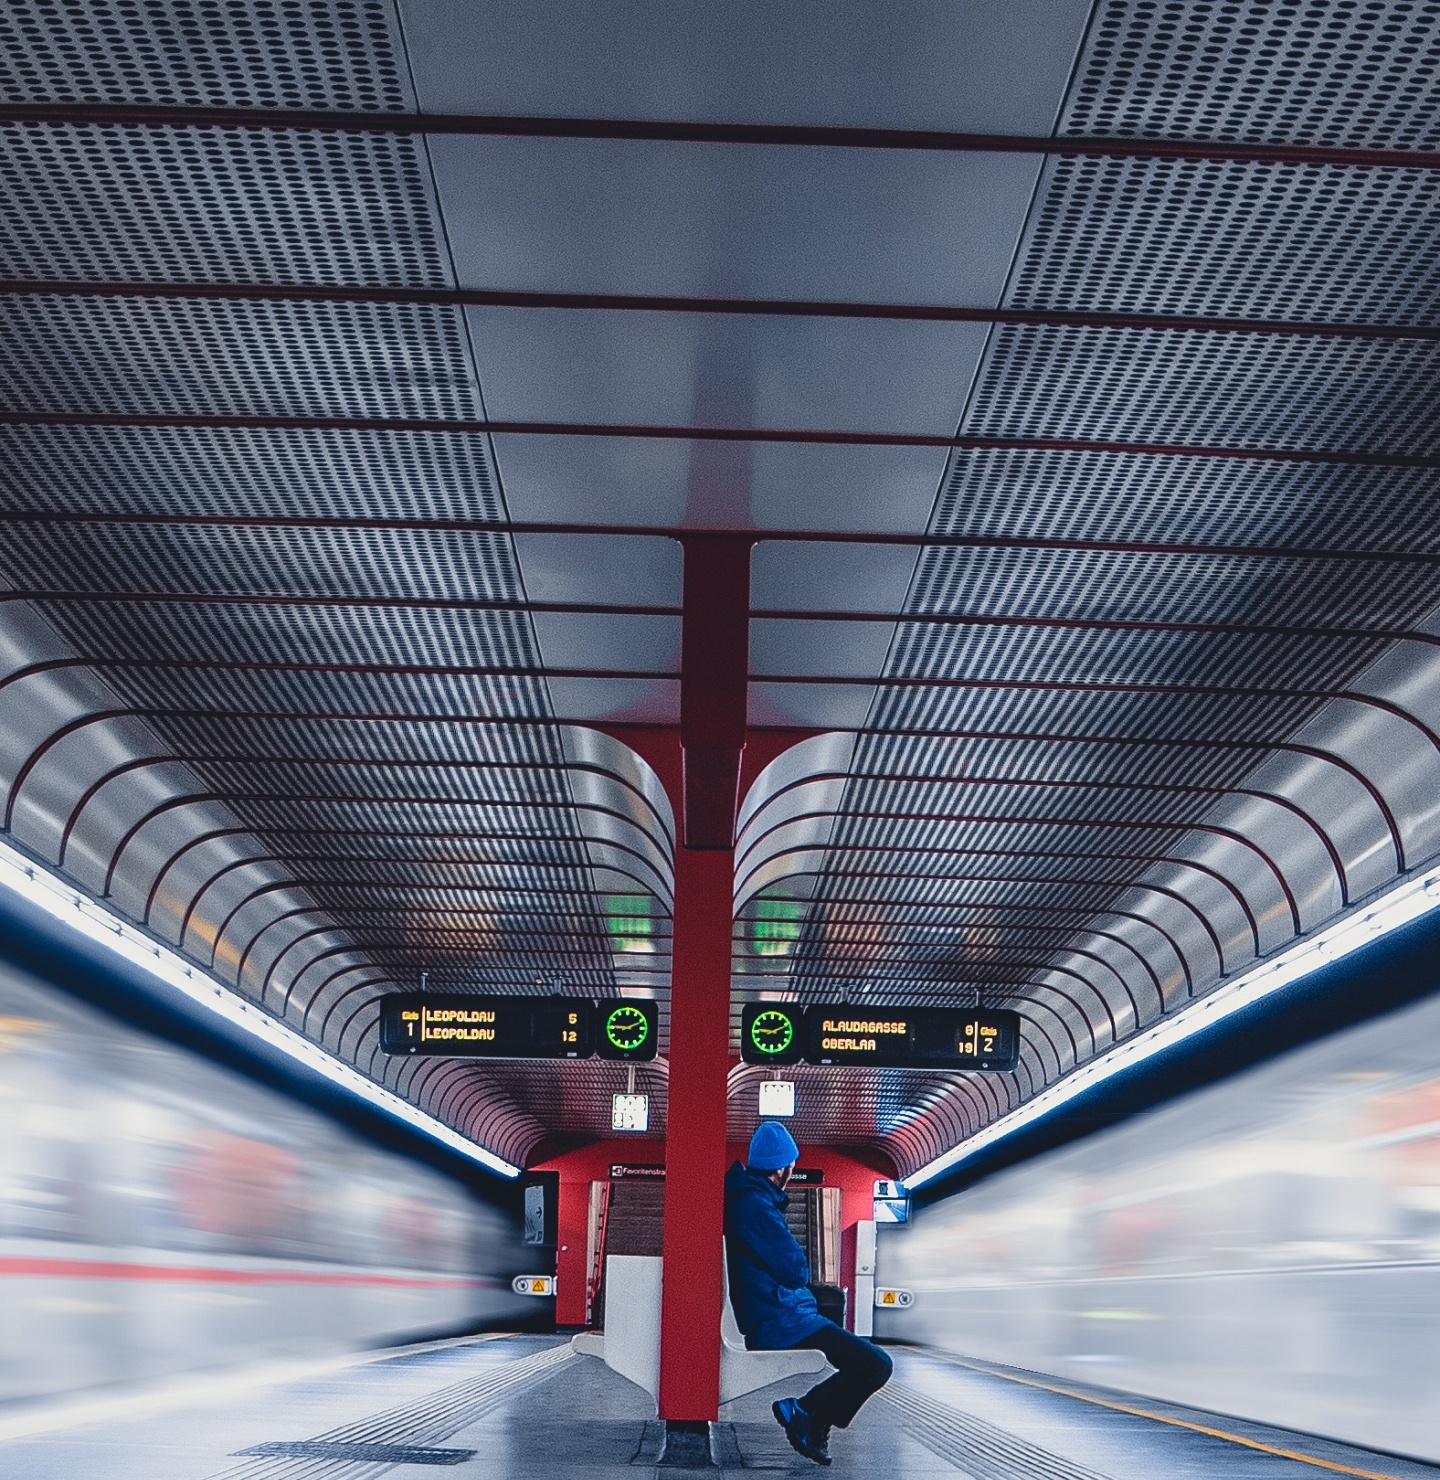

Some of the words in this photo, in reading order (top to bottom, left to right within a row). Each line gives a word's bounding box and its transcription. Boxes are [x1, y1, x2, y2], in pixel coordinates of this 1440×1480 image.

[426, 1010, 494, 1023] LEOPOLDAU
[568, 1013, 578, 1024] 5
[407, 1022, 413, 1036] 1
[822, 1020, 906, 1034] ALAUDAGASSE
[426, 1027, 494, 1040] LEOPOLDAU
[562, 1030, 577, 1042] 12
[821, 1038, 876, 1051] OBERLAA
[958, 1041, 973, 1053] 19
